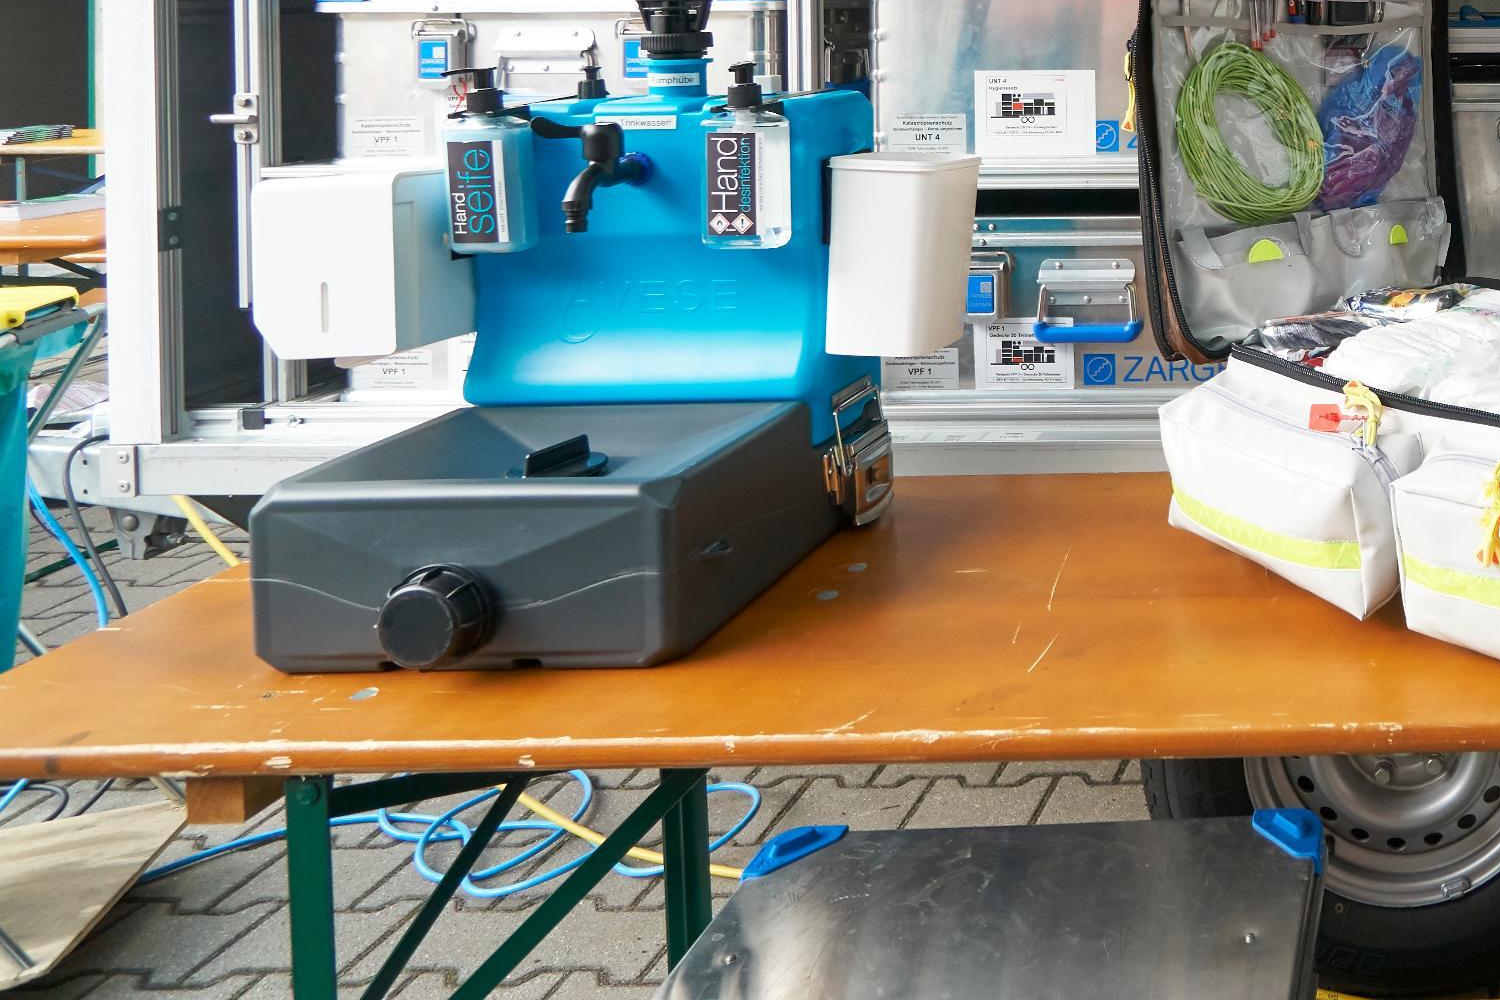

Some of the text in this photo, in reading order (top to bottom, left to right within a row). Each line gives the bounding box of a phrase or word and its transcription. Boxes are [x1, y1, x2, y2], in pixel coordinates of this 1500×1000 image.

[621, 118, 672, 127] Trinkwasser!
[374, 136, 391, 144] VPF
[915, 133, 933, 141] UNT
[710, 137, 739, 213] Hand
[738, 137, 751, 213] desinfektion
[456, 149, 495, 234] seife
[452, 192, 468, 235] Hand
[382, 367, 399, 375] VPF
[908, 367, 925, 375] VPF
